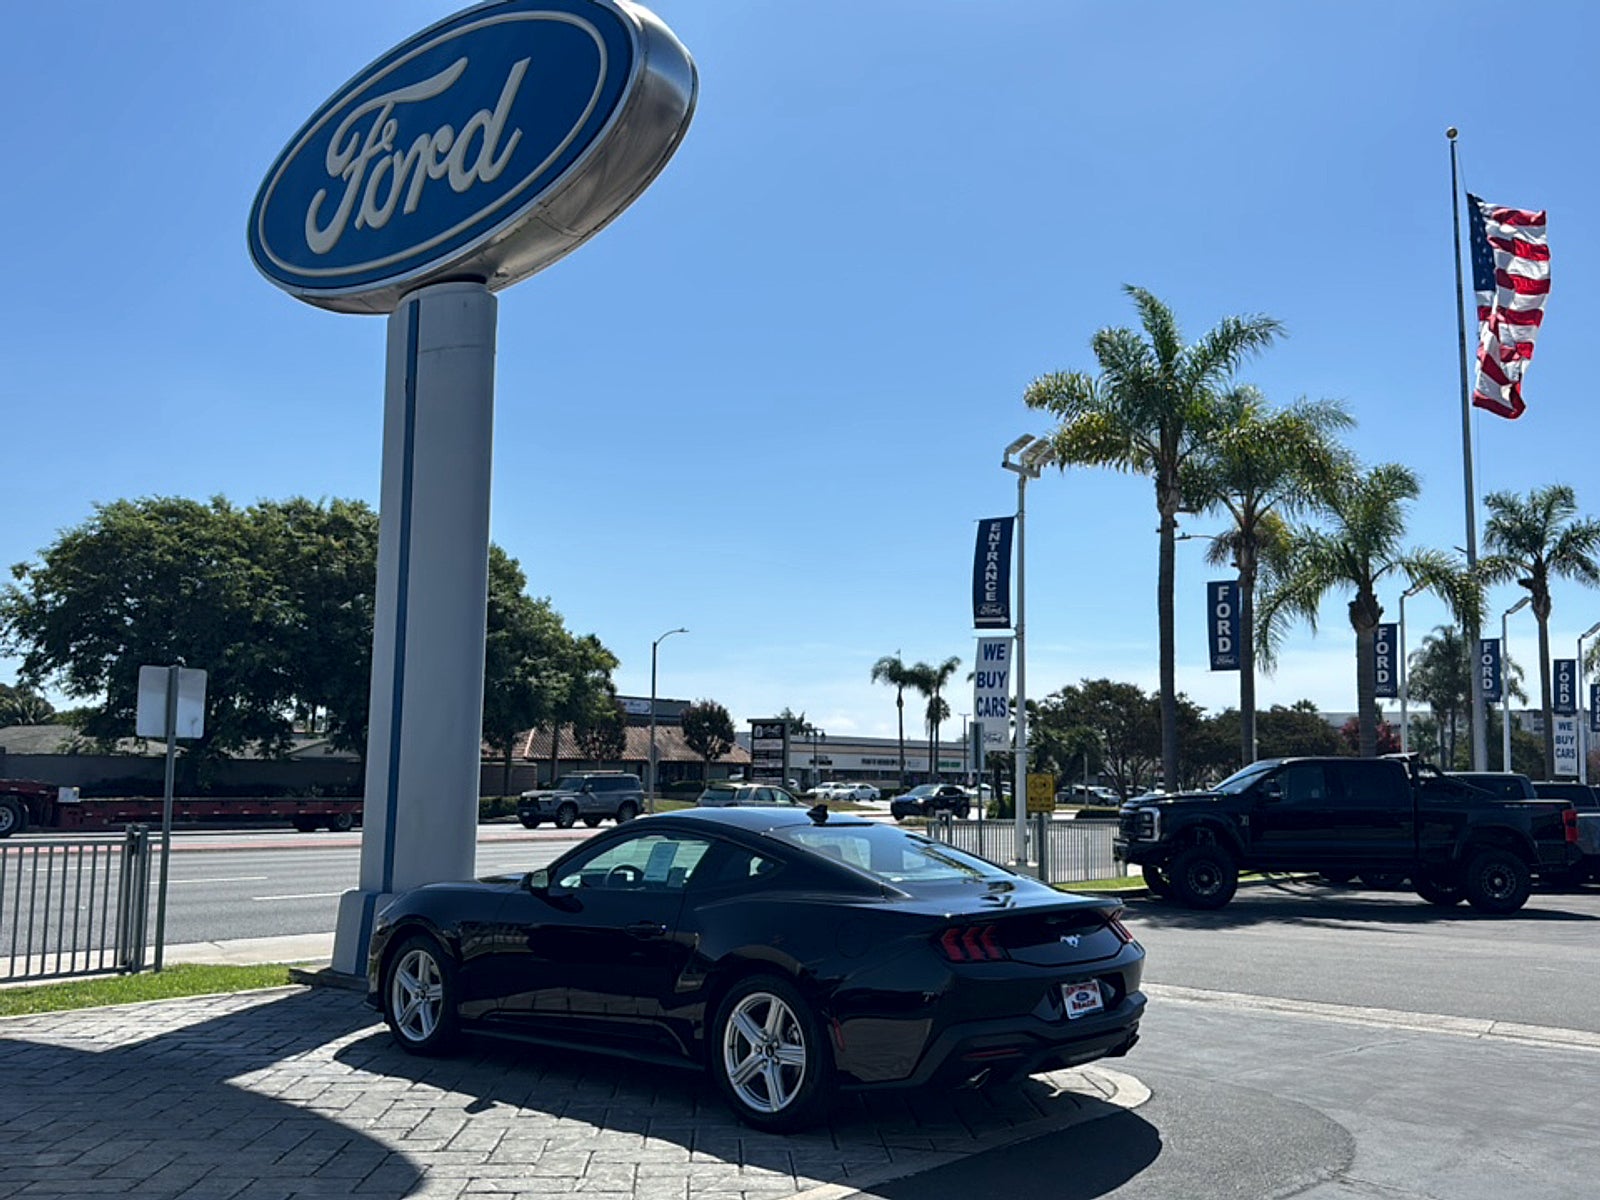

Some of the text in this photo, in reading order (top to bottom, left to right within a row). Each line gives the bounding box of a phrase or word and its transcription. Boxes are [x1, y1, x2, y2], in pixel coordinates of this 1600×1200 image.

[305, 57, 531, 254] Ford
[985, 522, 1001, 601] ENTRANCE
[1216, 585, 1231, 653] FORD
[983, 643, 1006, 661] WE
[1376, 627, 1389, 683] FORD
[1482, 641, 1493, 690] FORD
[976, 671, 1007, 689] BUY
[1559, 662, 1570, 704] FORD
[976, 696, 1007, 718] CARS
[1556, 735, 1575, 745] BUY
[1558, 722, 1573, 731] WE
[1556, 748, 1575, 759] CARS
